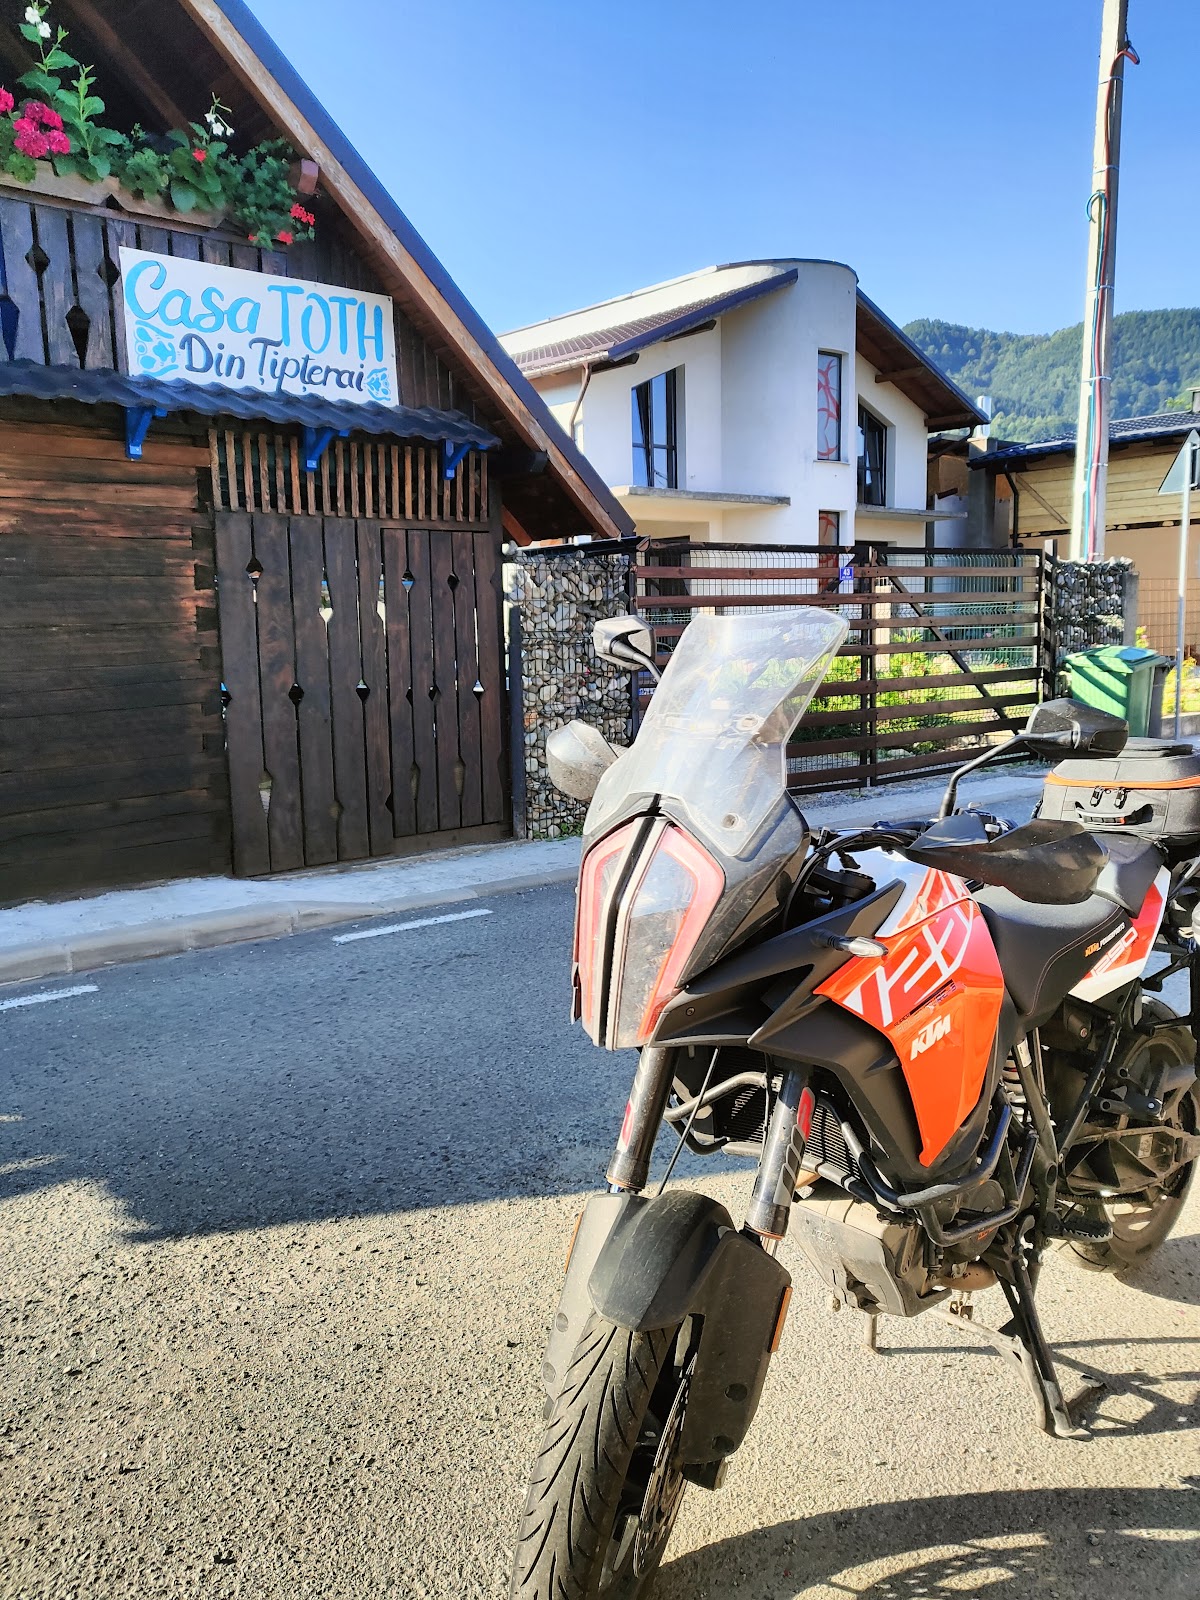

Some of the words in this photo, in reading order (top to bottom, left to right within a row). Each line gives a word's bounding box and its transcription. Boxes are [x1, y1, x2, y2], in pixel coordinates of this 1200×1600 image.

[125, 260, 261, 334] Casa
[267, 285, 384, 363] TOTH
[179, 333, 246, 380] Din
[1089, 926, 1139, 977] 1290
[910, 1013, 951, 1061] KTM
